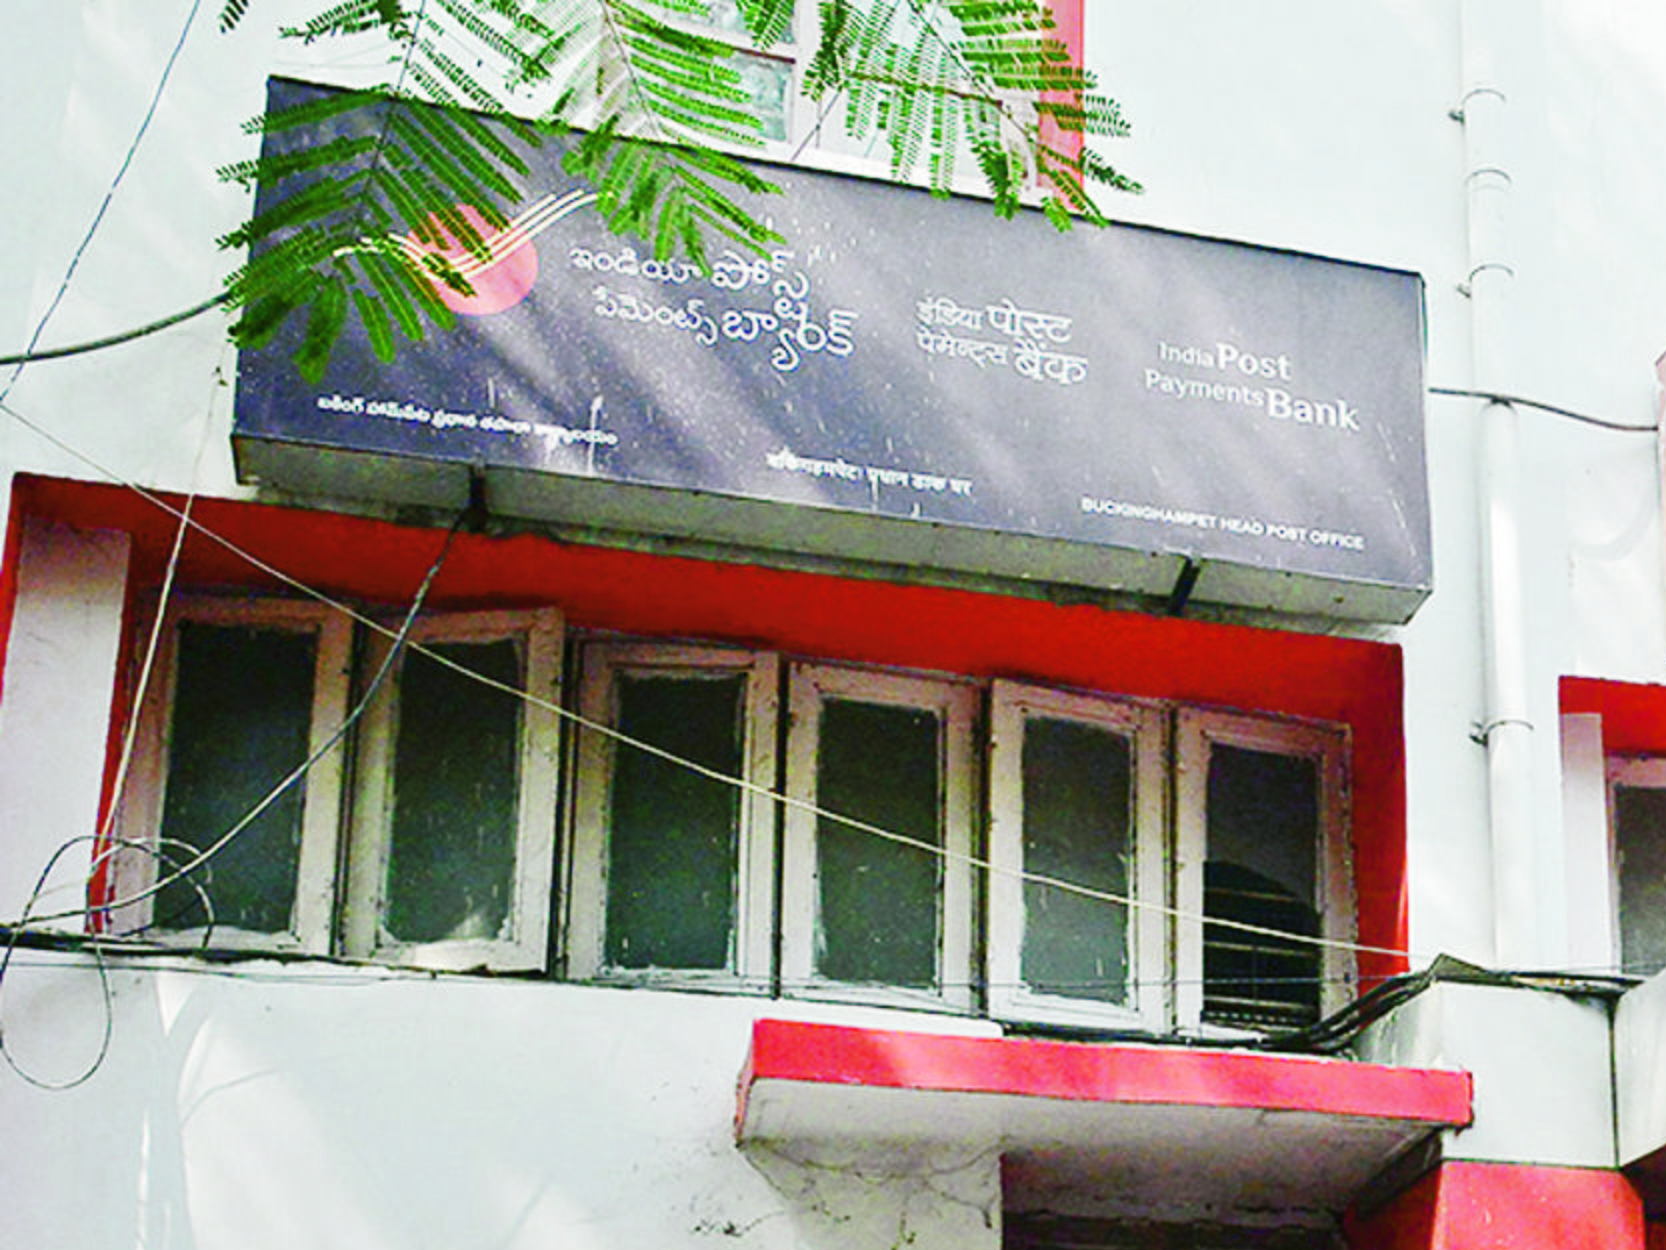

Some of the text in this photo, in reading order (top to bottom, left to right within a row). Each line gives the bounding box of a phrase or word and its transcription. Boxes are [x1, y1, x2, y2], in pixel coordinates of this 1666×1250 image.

[915, 297, 1074, 344] इंडिया पोस्ट
[1012, 337, 1090, 386] बैंक
[1080, 496, 1364, 550] BUCKINGHAMPET HEAD POST OFFICE
